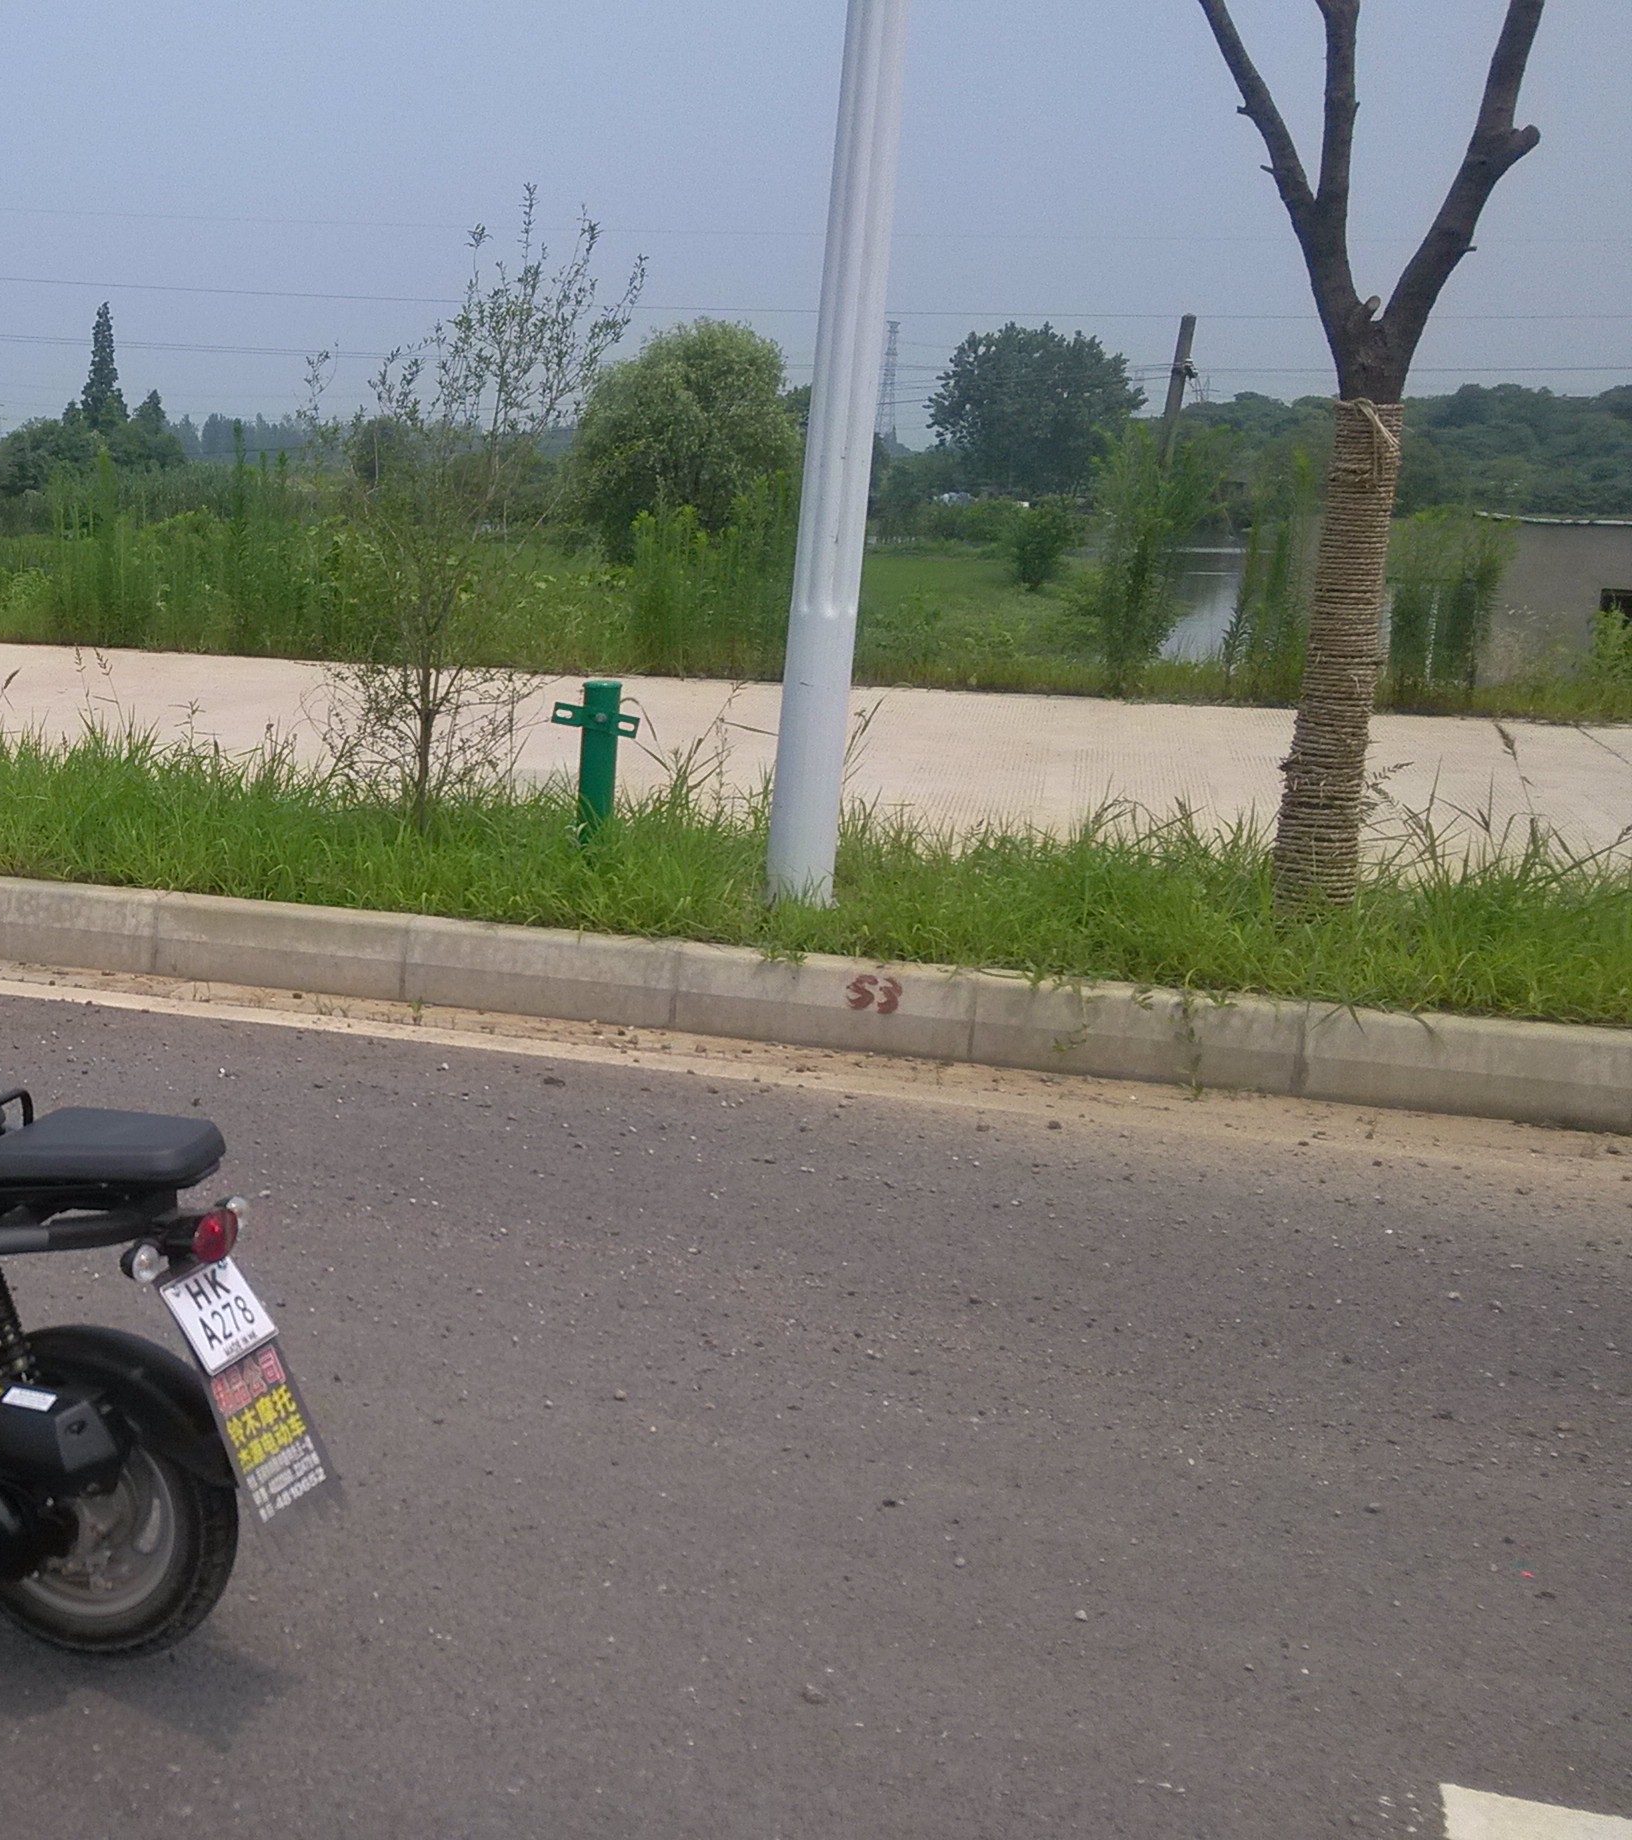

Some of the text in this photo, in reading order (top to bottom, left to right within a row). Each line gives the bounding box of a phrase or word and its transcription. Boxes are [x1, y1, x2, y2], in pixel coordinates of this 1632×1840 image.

[184, 1267, 231, 1311] HK
[197, 1296, 256, 1351] A278
[226, 1384, 297, 1448] 铃木摩托
